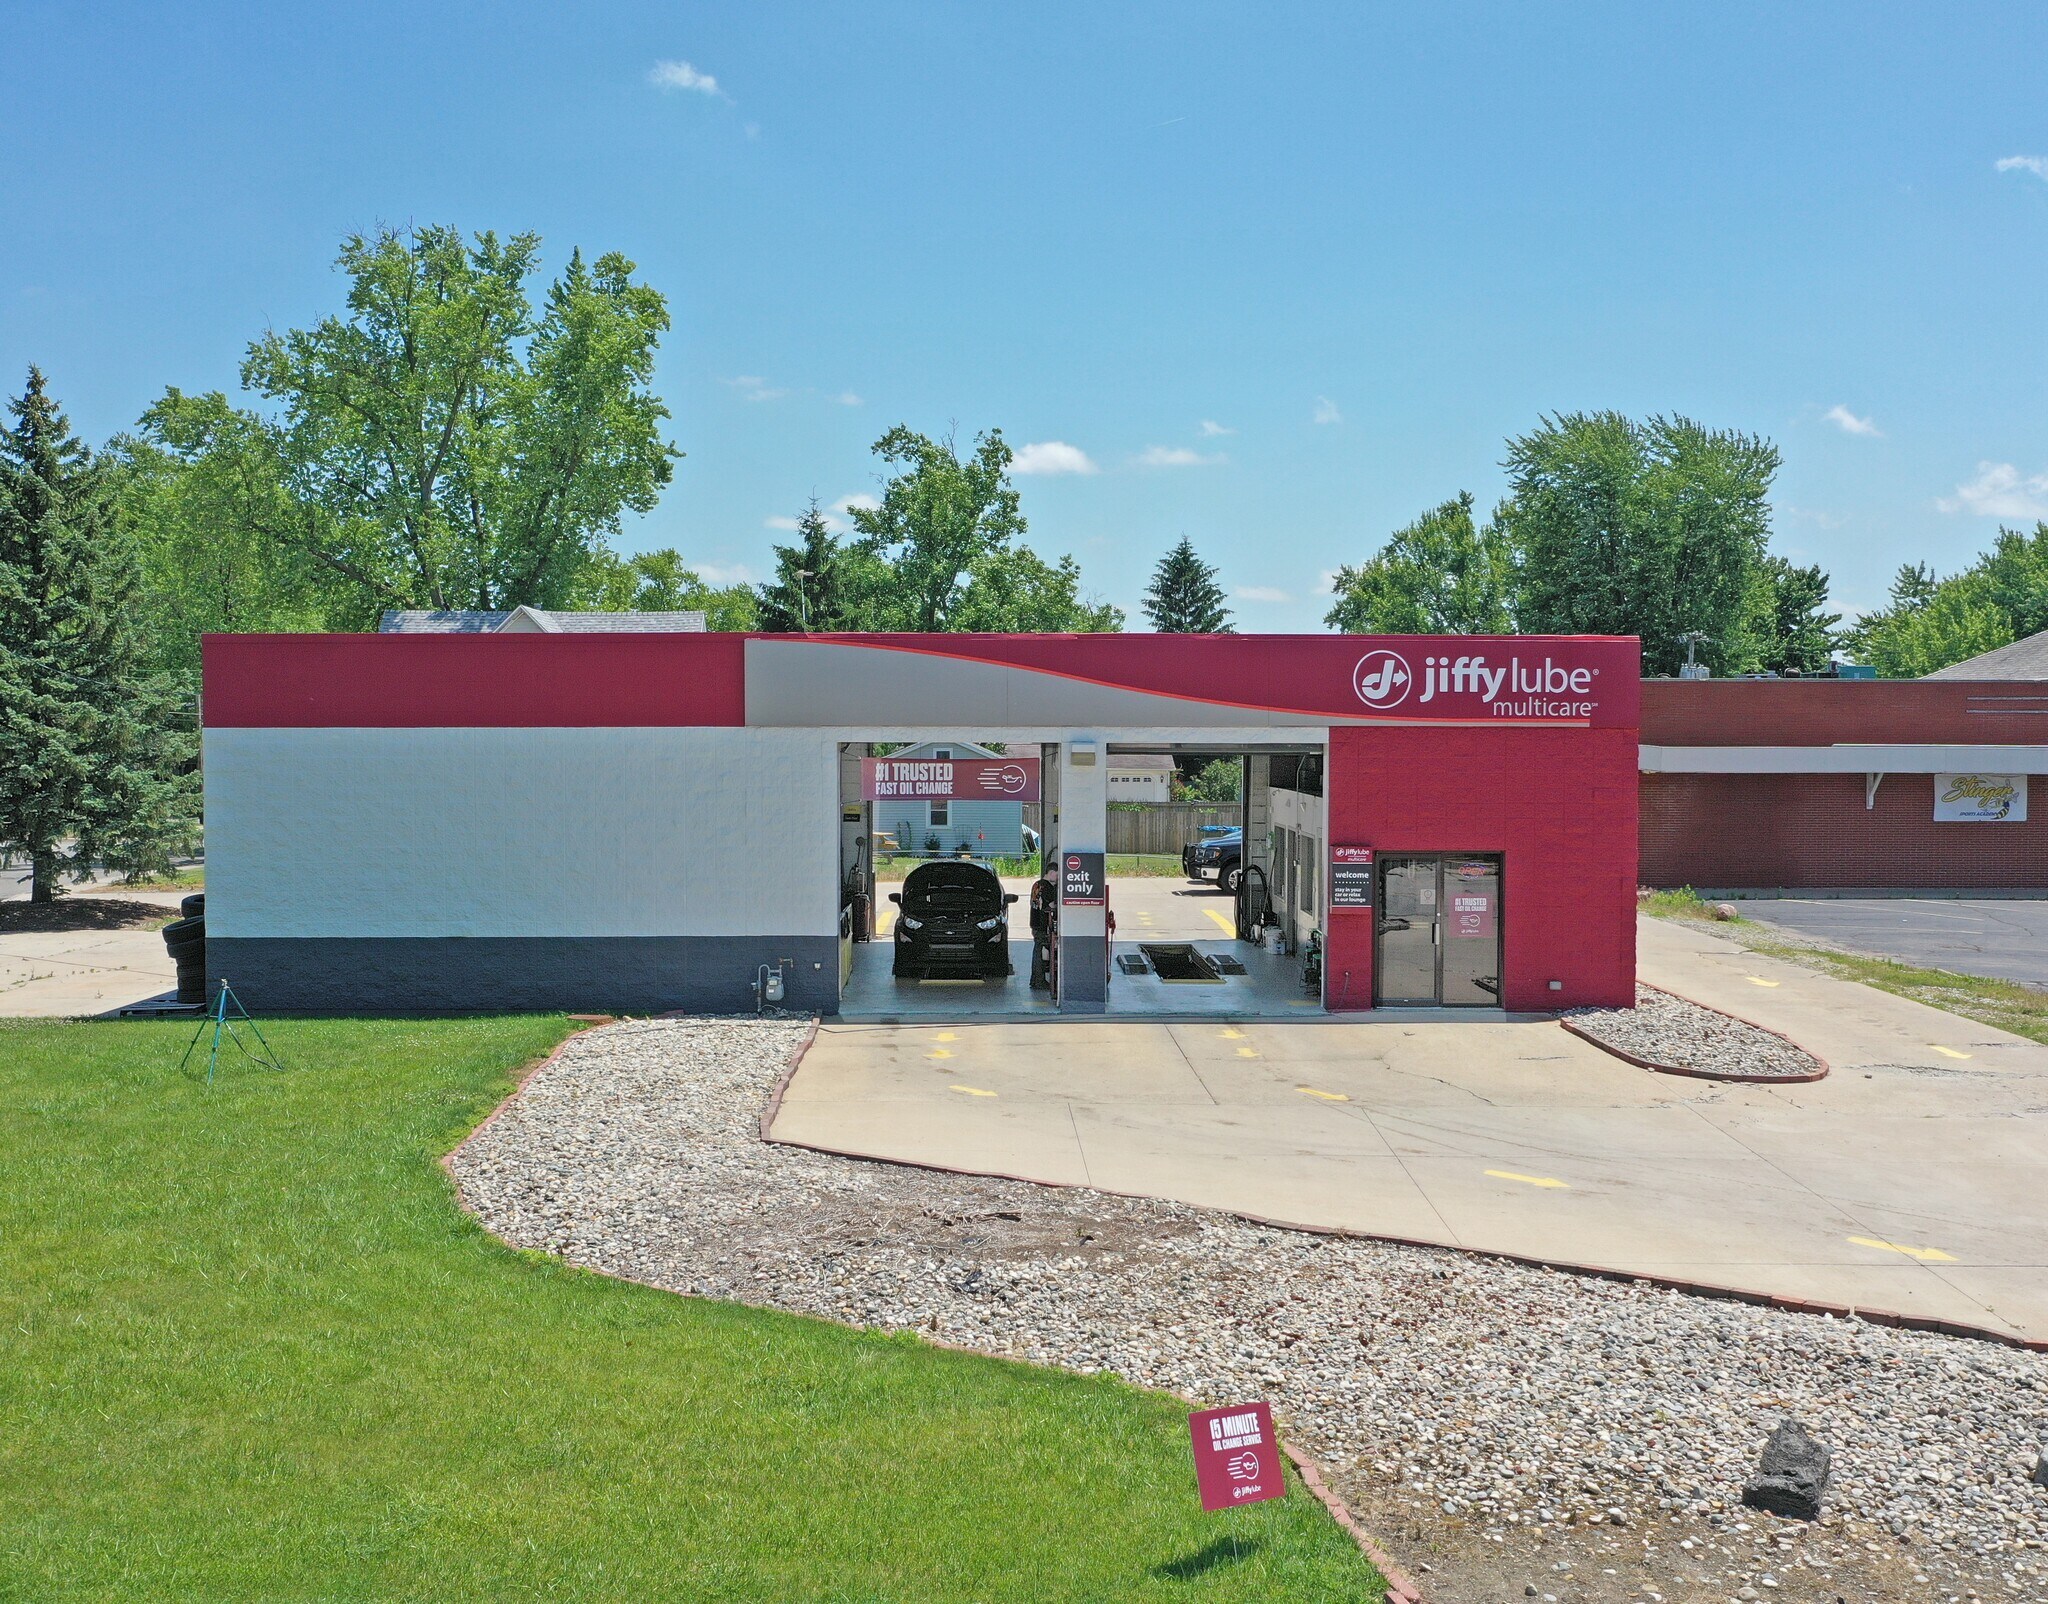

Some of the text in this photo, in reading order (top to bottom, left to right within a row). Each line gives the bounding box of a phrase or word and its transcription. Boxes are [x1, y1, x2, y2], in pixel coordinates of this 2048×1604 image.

[1419, 656, 1506, 703] jiffy
[1493, 696, 1592, 717] multicare
[875, 762, 953, 781] #1 TRUSTED
[875, 782, 953, 795] FAST OIL CHANGE
[1941, 775, 2014, 808] Stinger
[1067, 871, 1090, 881] exit
[1067, 882, 1093, 895] only
[1209, 1412, 1260, 1440] 15 MINUTE
[1212, 1433, 1262, 1452] OIL CHANGE SERVICE
